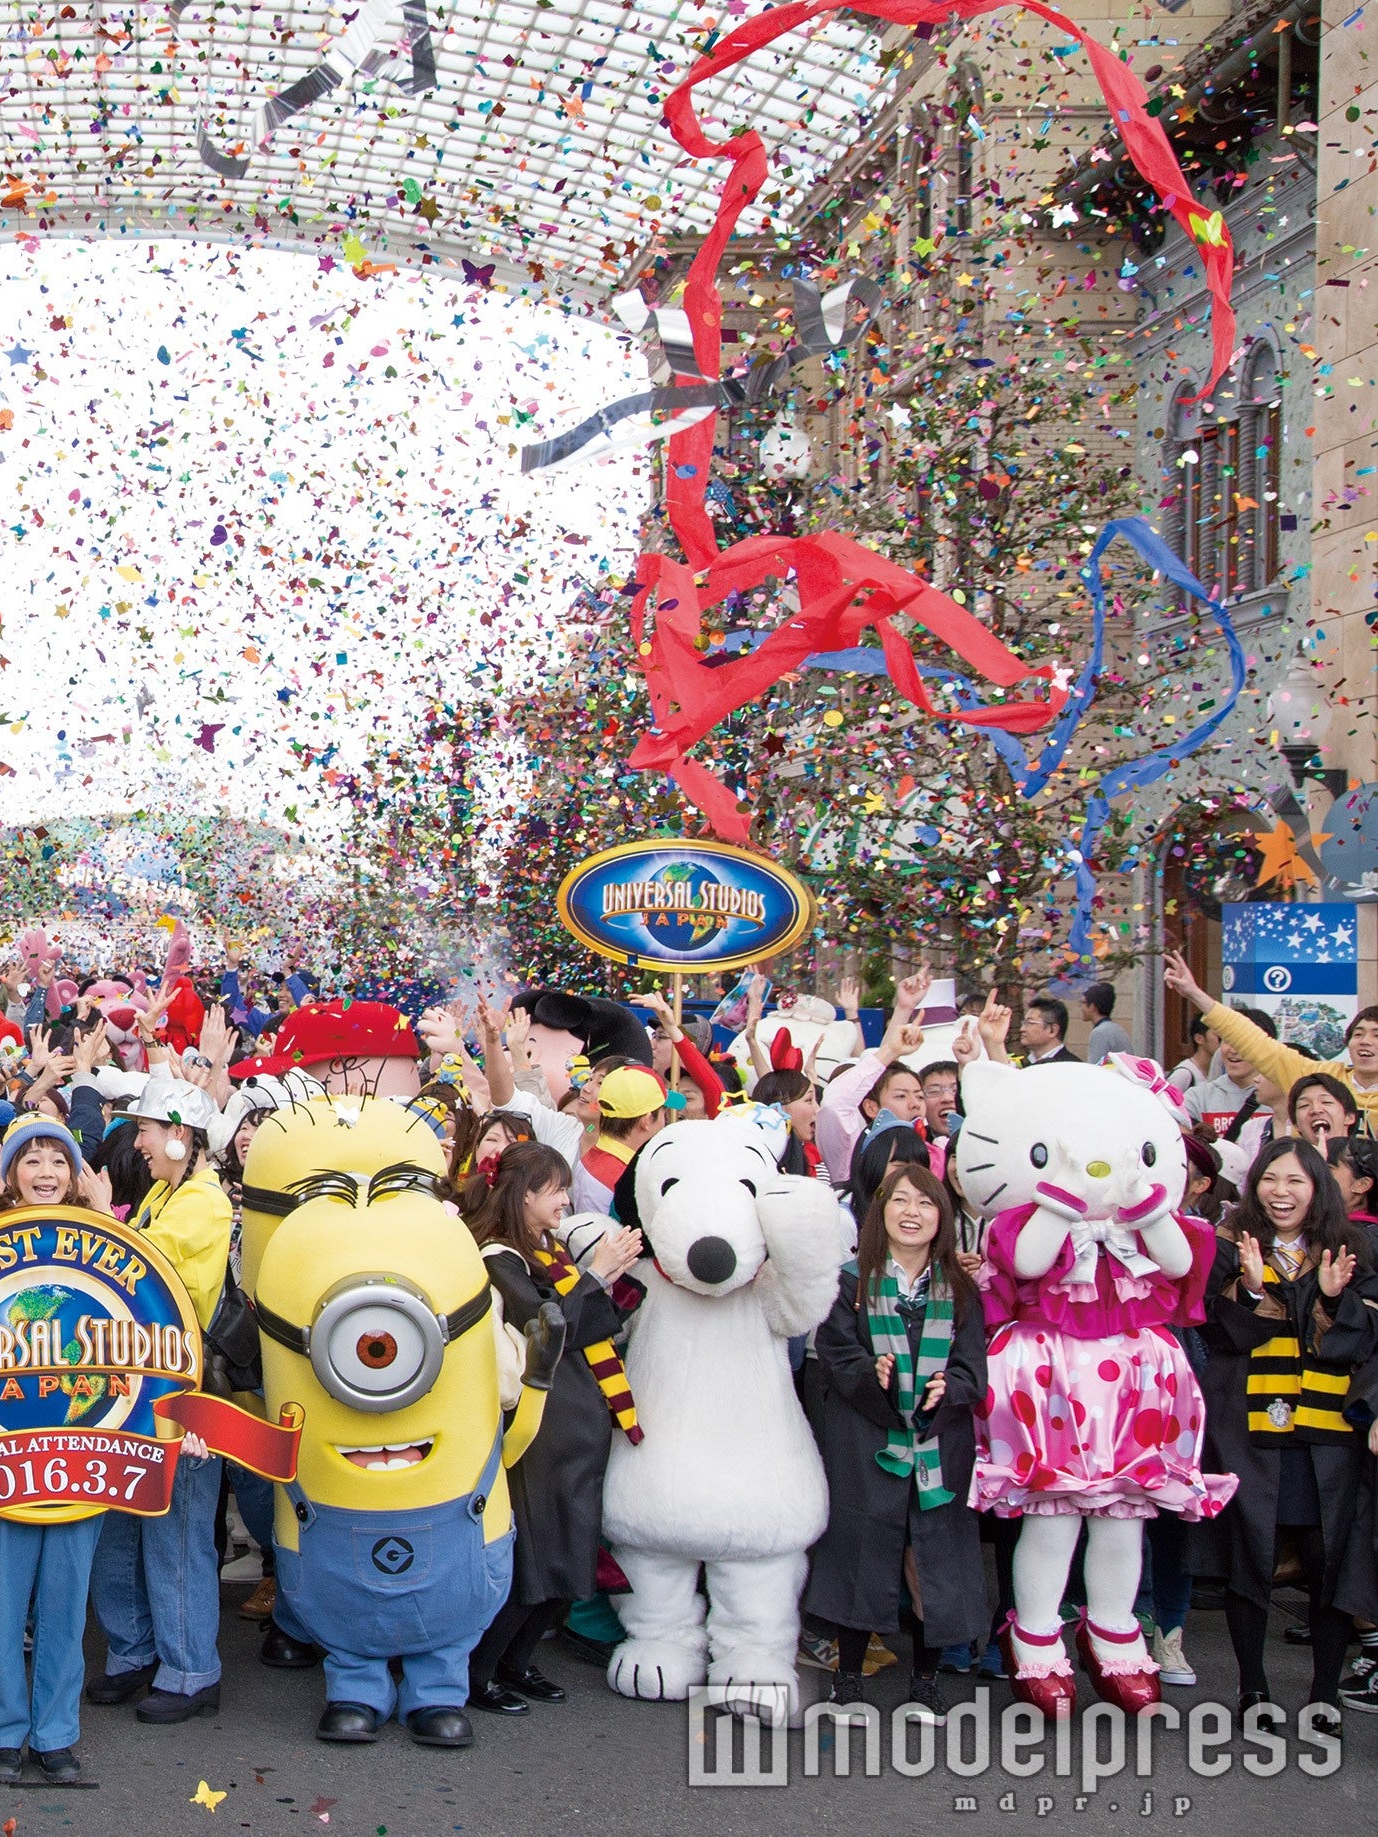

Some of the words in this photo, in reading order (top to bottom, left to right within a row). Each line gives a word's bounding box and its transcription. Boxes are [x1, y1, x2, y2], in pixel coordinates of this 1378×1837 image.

[602, 881, 695, 913] UNIVERSAL
[699, 880, 766, 920] STUDIOS
[640, 912, 728, 929] JAPAN
[52, 1226, 148, 1296] EVER
[75, 1314, 197, 1377] STUDIOS
[26, 1436, 165, 1464] ATTENDANCE
